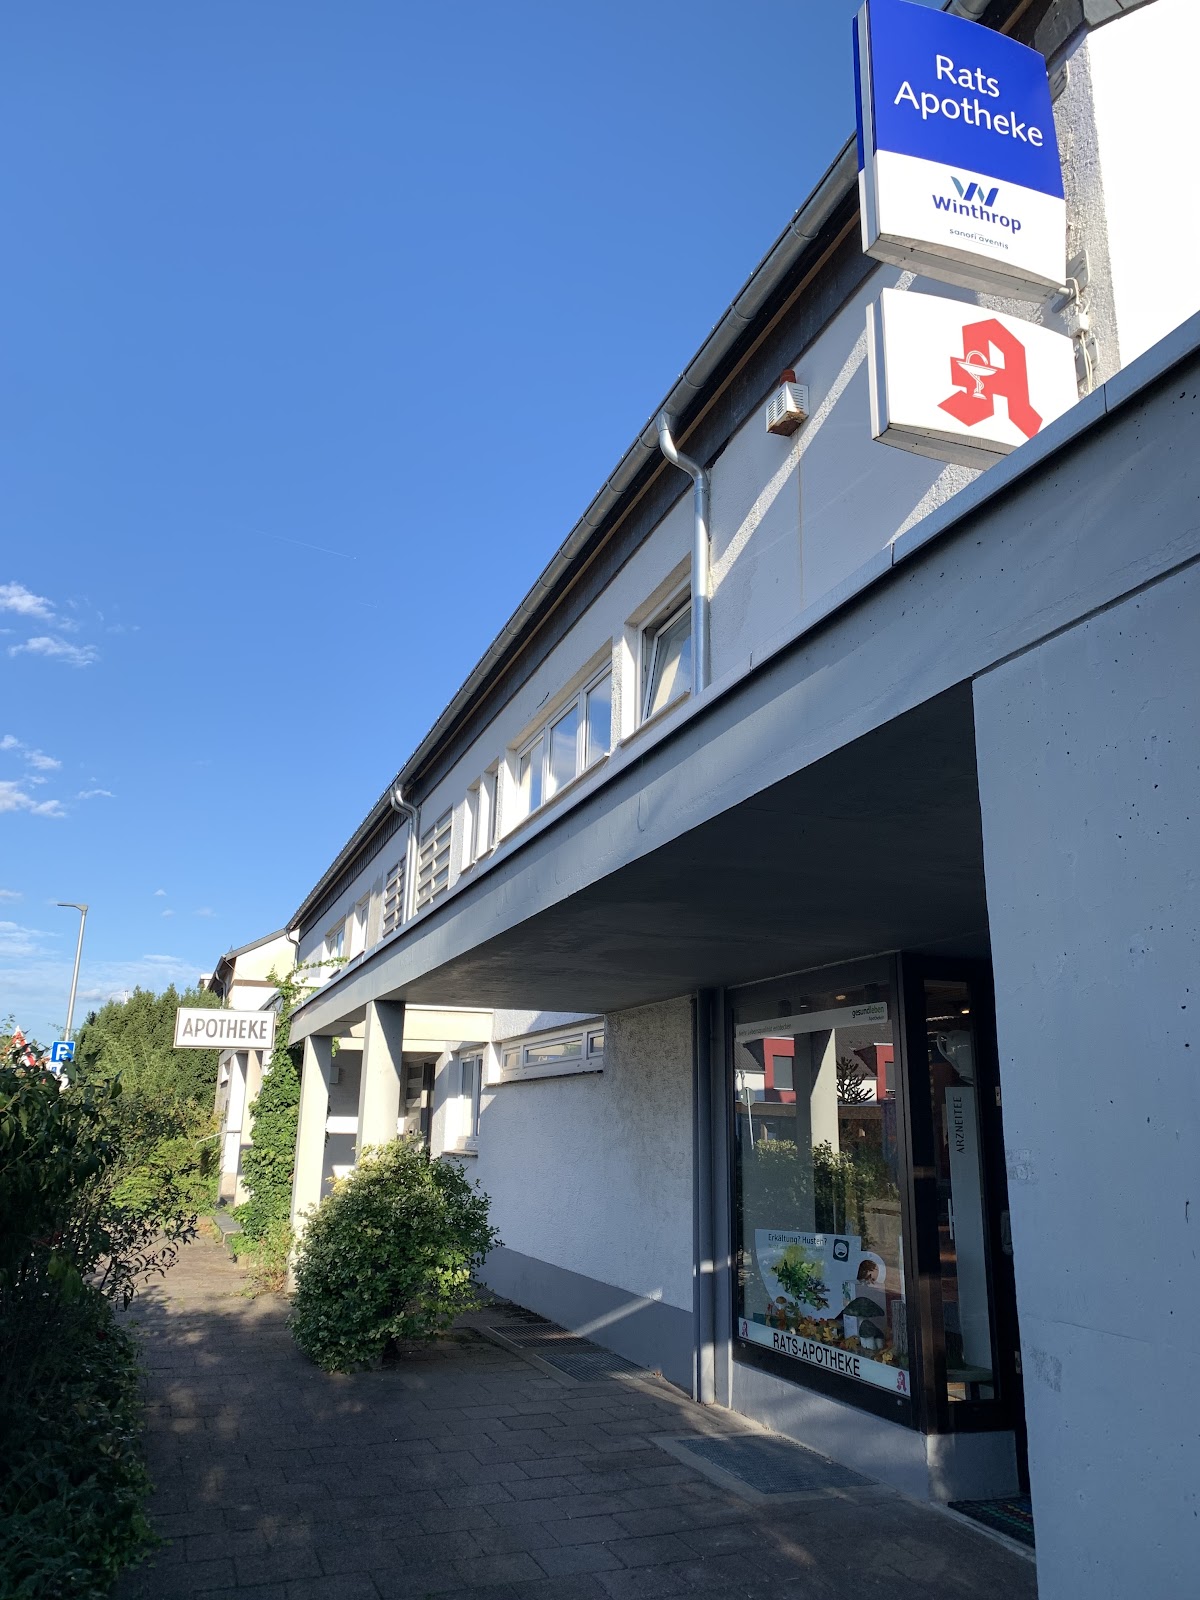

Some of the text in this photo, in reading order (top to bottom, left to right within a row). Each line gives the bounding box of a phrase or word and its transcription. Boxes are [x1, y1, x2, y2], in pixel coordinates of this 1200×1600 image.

[936, 54, 1000, 98] Rats
[894, 81, 1044, 147] Apotheke
[932, 194, 1021, 234] Winthrop
[182, 1017, 267, 1040] APOTHEKE
[953, 1096, 965, 1155] ARZNEITEE
[768, 1233, 828, 1245] Erkältung? Husten?
[773, 1332, 861, 1378] RATS-APOTHEKE
